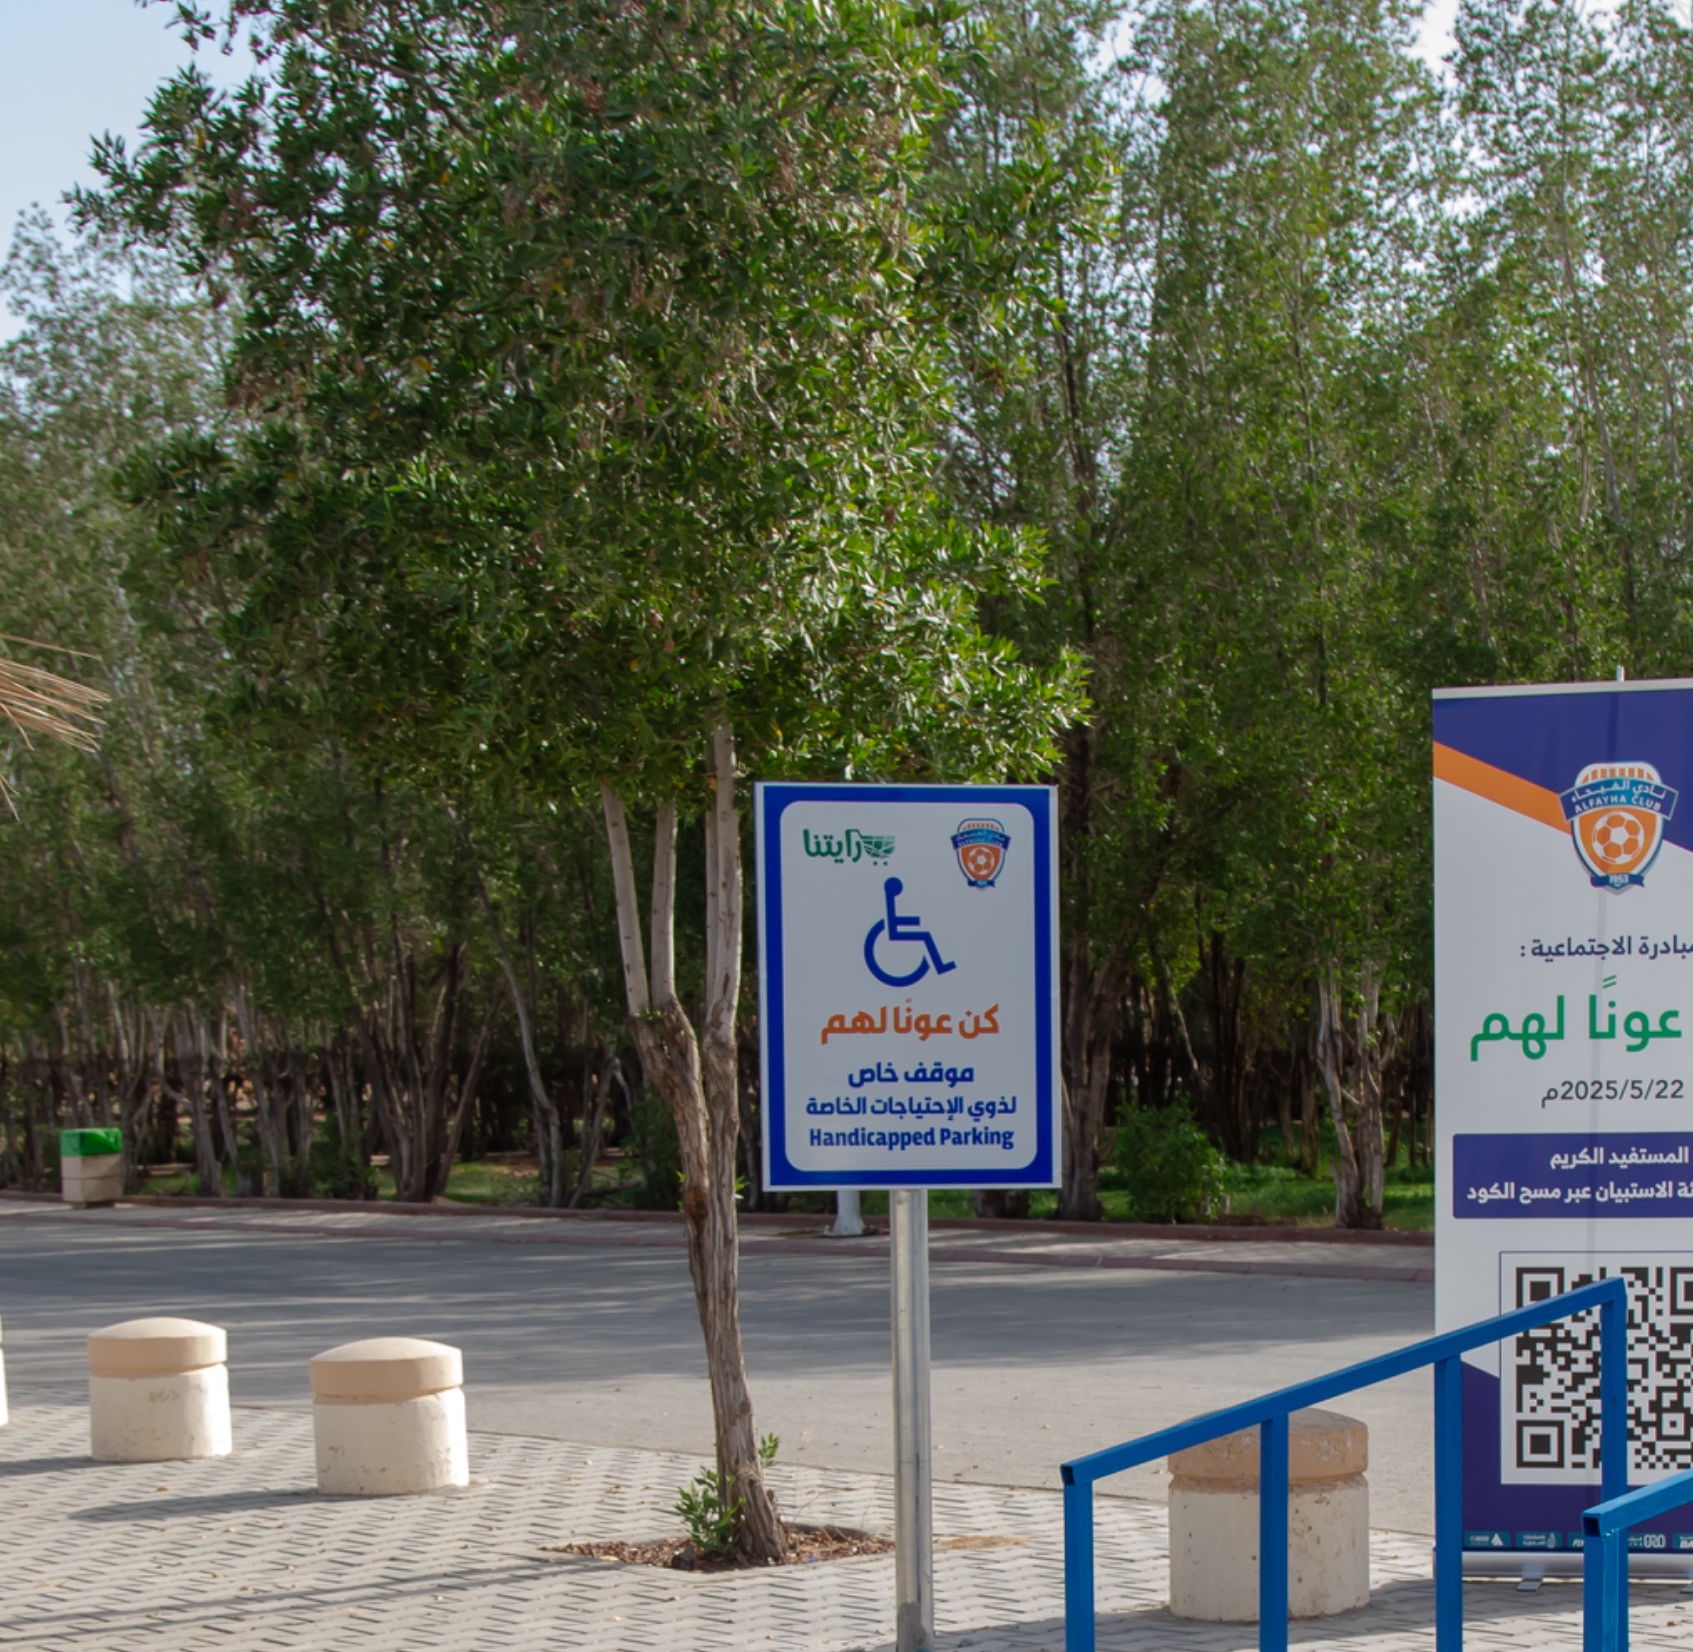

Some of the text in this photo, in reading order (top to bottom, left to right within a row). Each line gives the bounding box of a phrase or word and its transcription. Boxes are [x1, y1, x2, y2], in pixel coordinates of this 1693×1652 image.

[1574, 794, 1662, 814] ALFAYHA CLUB
[1531, 935, 1632, 962] الاجتماعية
[821, 1006, 887, 1046] لهم
[959, 1003, 999, 1040] كن
[1470, 994, 1564, 1062] لهم
[848, 1061, 975, 1089] موقف خاص
[806, 1096, 1017, 1122] لذوي الإحتياجات الخاصة
[809, 1126, 1015, 1150] Handicapped Parking
[1549, 1147, 1689, 1169] المستفيد الكريم
[1467, 1182, 1515, 1204] الكود
[1519, 1187, 1561, 1205] مسح
[1564, 1185, 1591, 1203] عبر
[1595, 1181, 1673, 1203] الاستبيان
